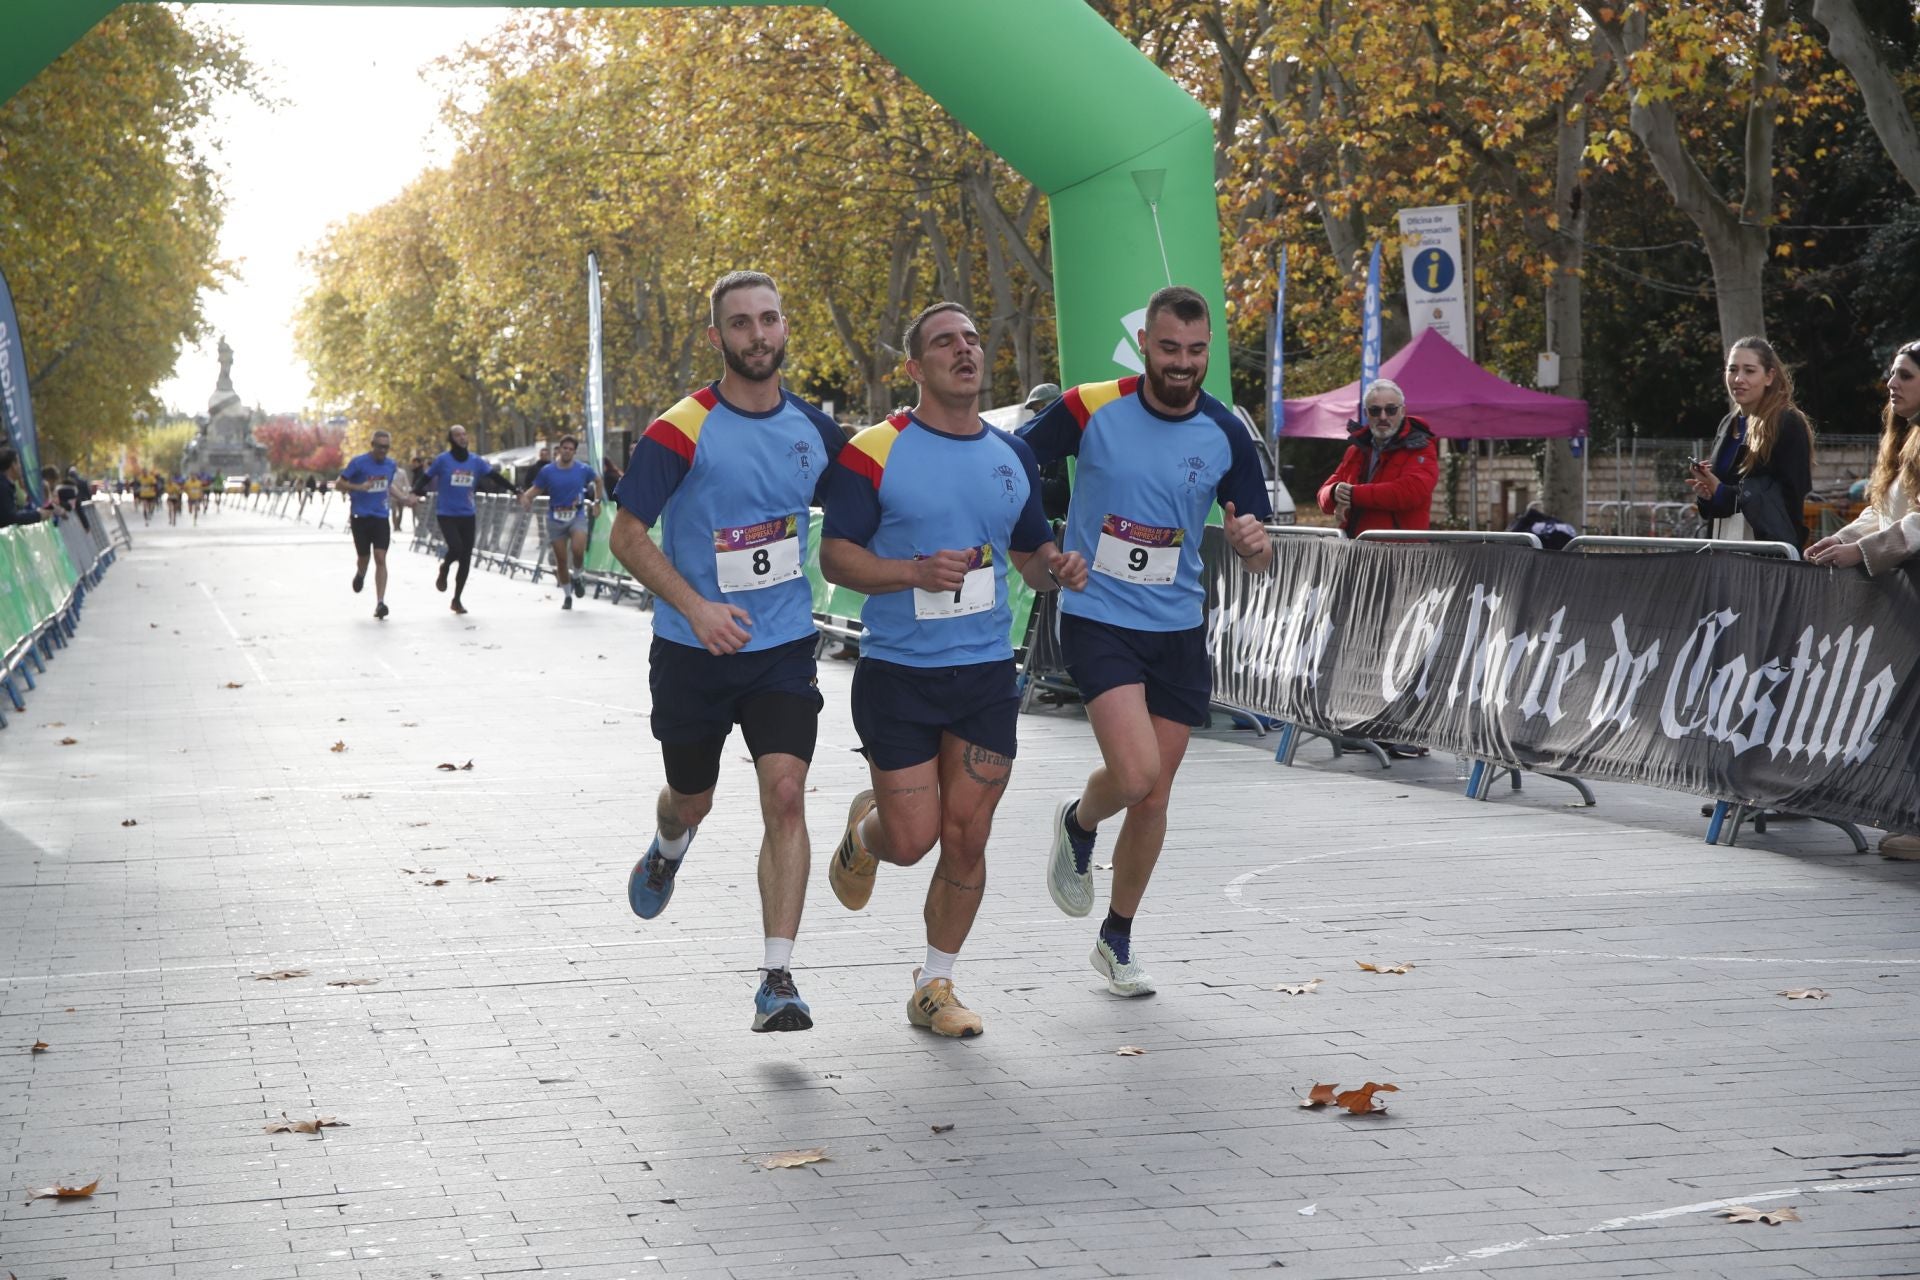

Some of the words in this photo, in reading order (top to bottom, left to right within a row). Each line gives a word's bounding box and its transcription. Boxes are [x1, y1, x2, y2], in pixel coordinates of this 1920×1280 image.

[1407, 216, 1432, 225] Oficina
[1433, 215, 1443, 223] de
[745, 528, 774, 541] EMPRESAS
[1130, 528, 1161, 541] EMPRESAS
[752, 548, 771, 576] 8
[1127, 547, 1149, 572] 9
[1447, 583, 1587, 728] Norte
[1586, 612, 1661, 735] de
[1659, 605, 1897, 769] Castilla
